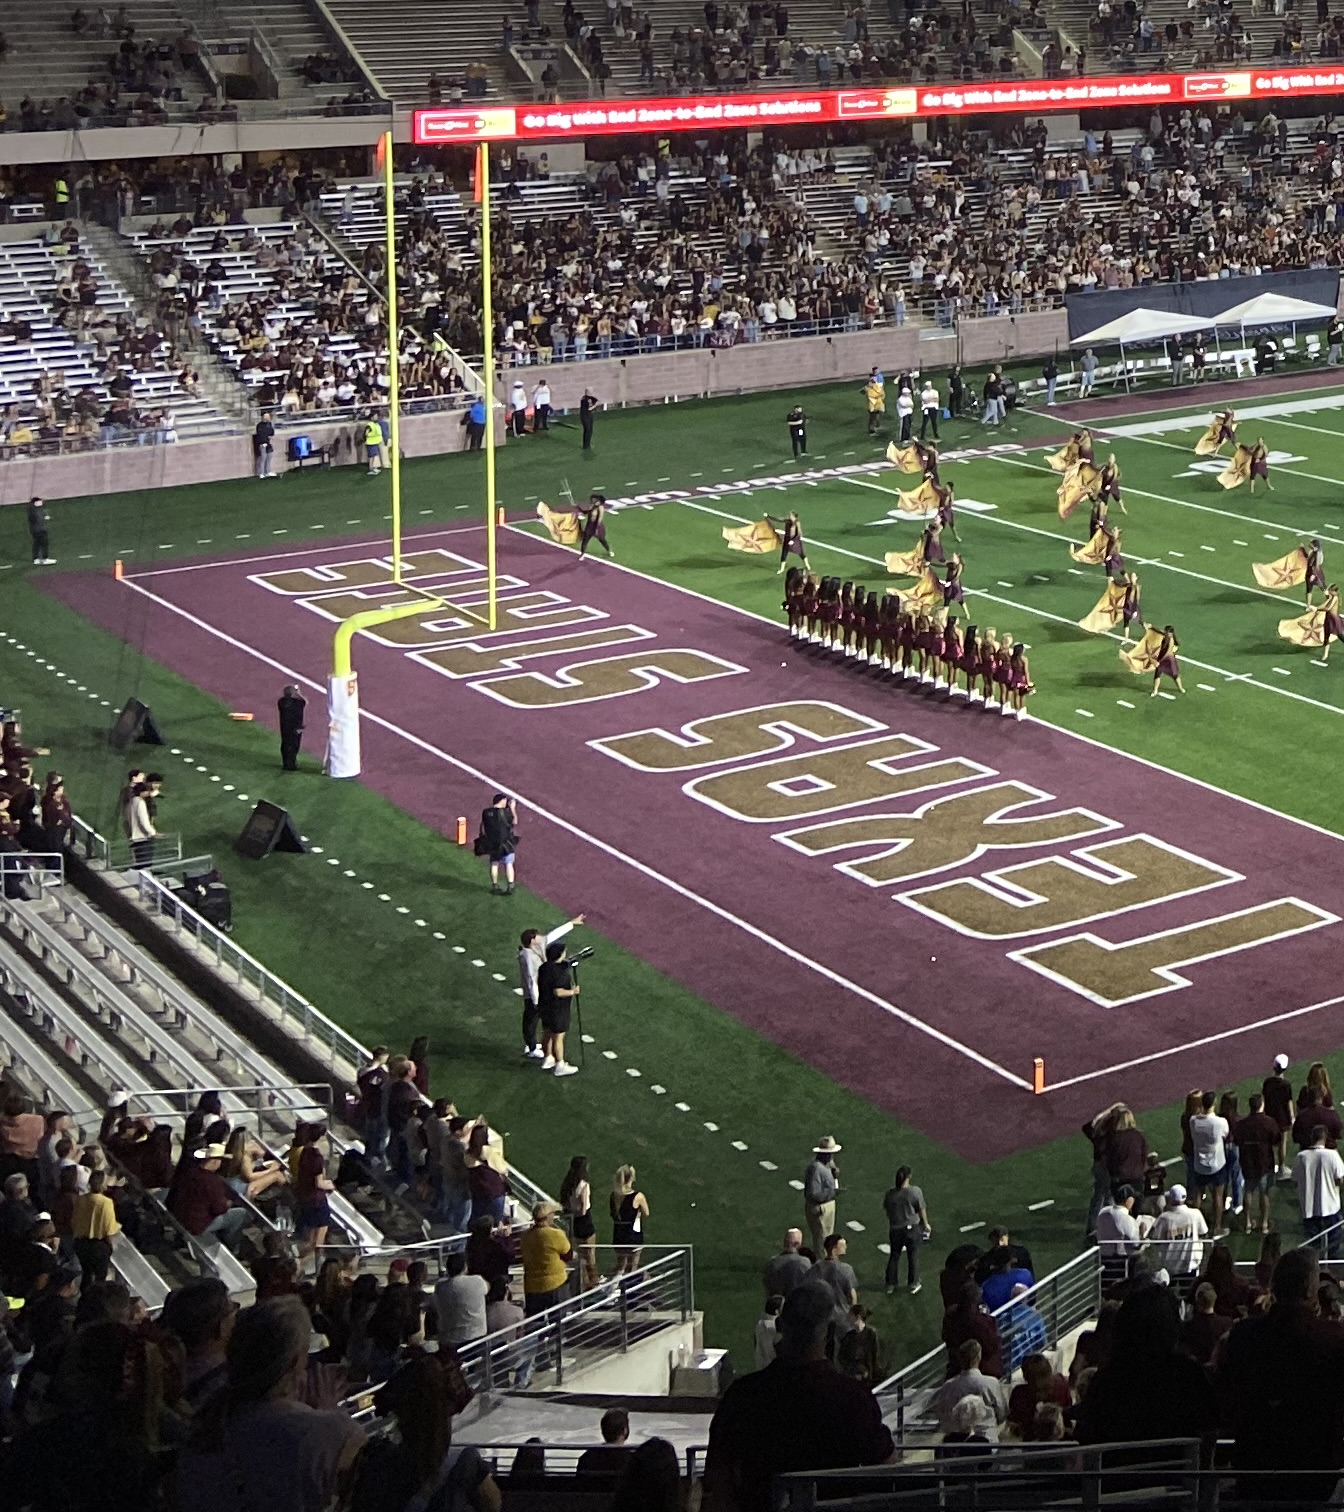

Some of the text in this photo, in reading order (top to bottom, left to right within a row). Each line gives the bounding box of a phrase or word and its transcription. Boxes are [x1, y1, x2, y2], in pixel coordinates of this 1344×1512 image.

[1256, 78, 1271, 89] Go
[1272, 76, 1289, 90] Big
[1290, 74, 1313, 87] With
[923, 93, 941, 107] Go
[943, 92, 963, 108] Big
[964, 90, 992, 104] With
[523, 114, 545, 128] Go
[547, 112, 571, 129] Big
[573, 110, 606, 125] With
[246, 548, 1343, 1008] TEXAS STATE
